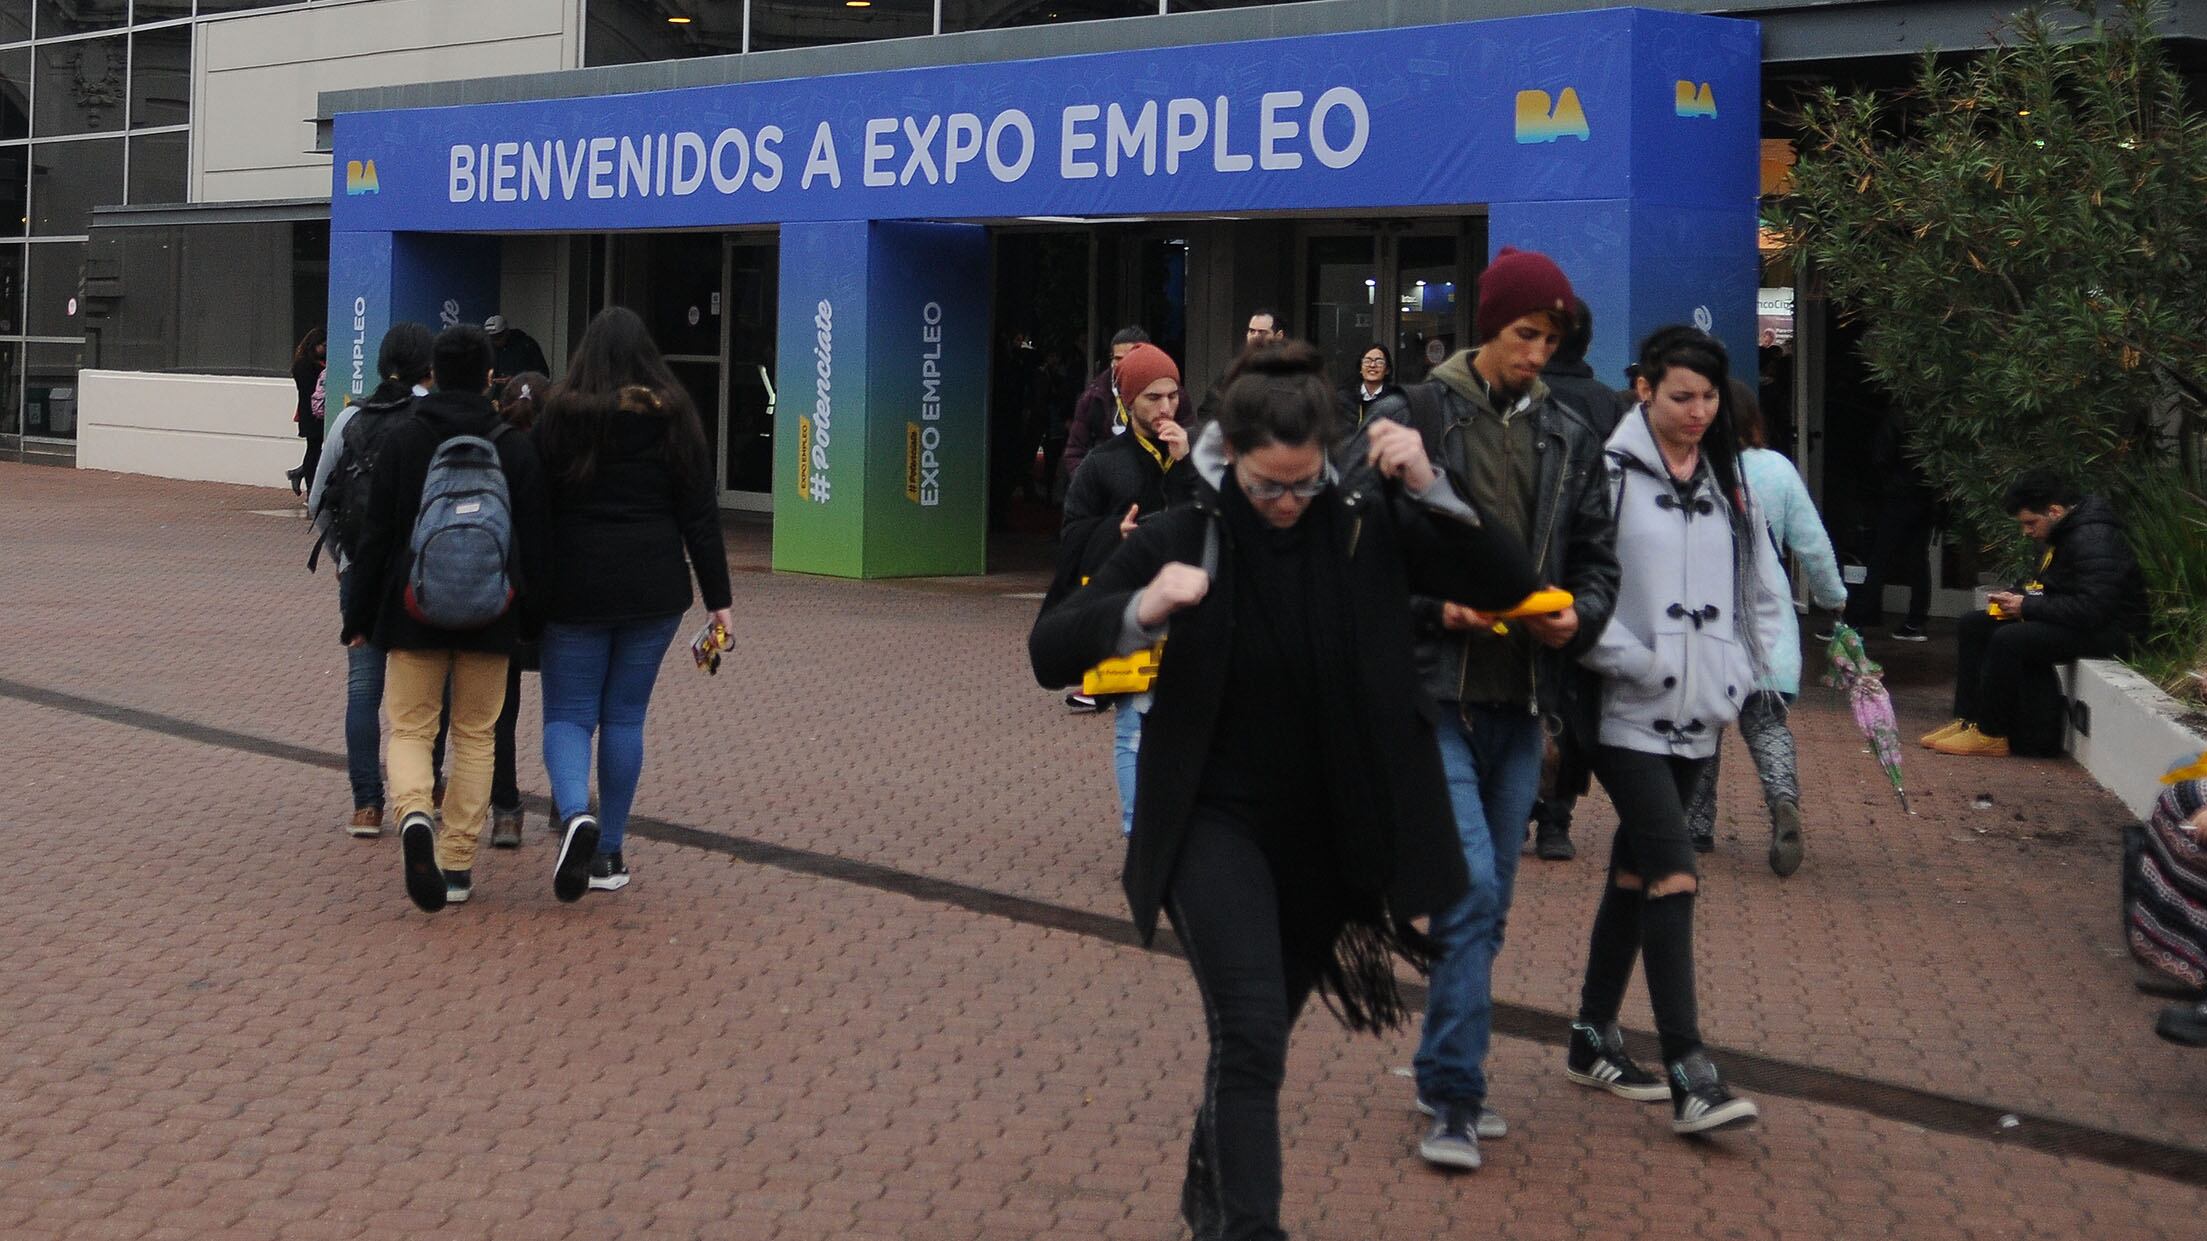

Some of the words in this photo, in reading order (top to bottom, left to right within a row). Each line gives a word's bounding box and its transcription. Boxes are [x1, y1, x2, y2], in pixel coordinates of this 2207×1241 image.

[1515, 87, 1590, 145] BA
[1675, 81, 1718, 119] BA
[346, 159, 380, 196] BA
[449, 127, 784, 203] BIENVENIDOS
[801, 121, 842, 190] A
[863, 108, 1035, 187] EXPO
[1060, 86, 1370, 180] EMPLEO
[351, 296, 366, 395] EMPLEO
[922, 302, 942, 421] EMPLEO
[800, 424, 808, 463] EMPLEO
[920, 426, 940, 506] EXPO
